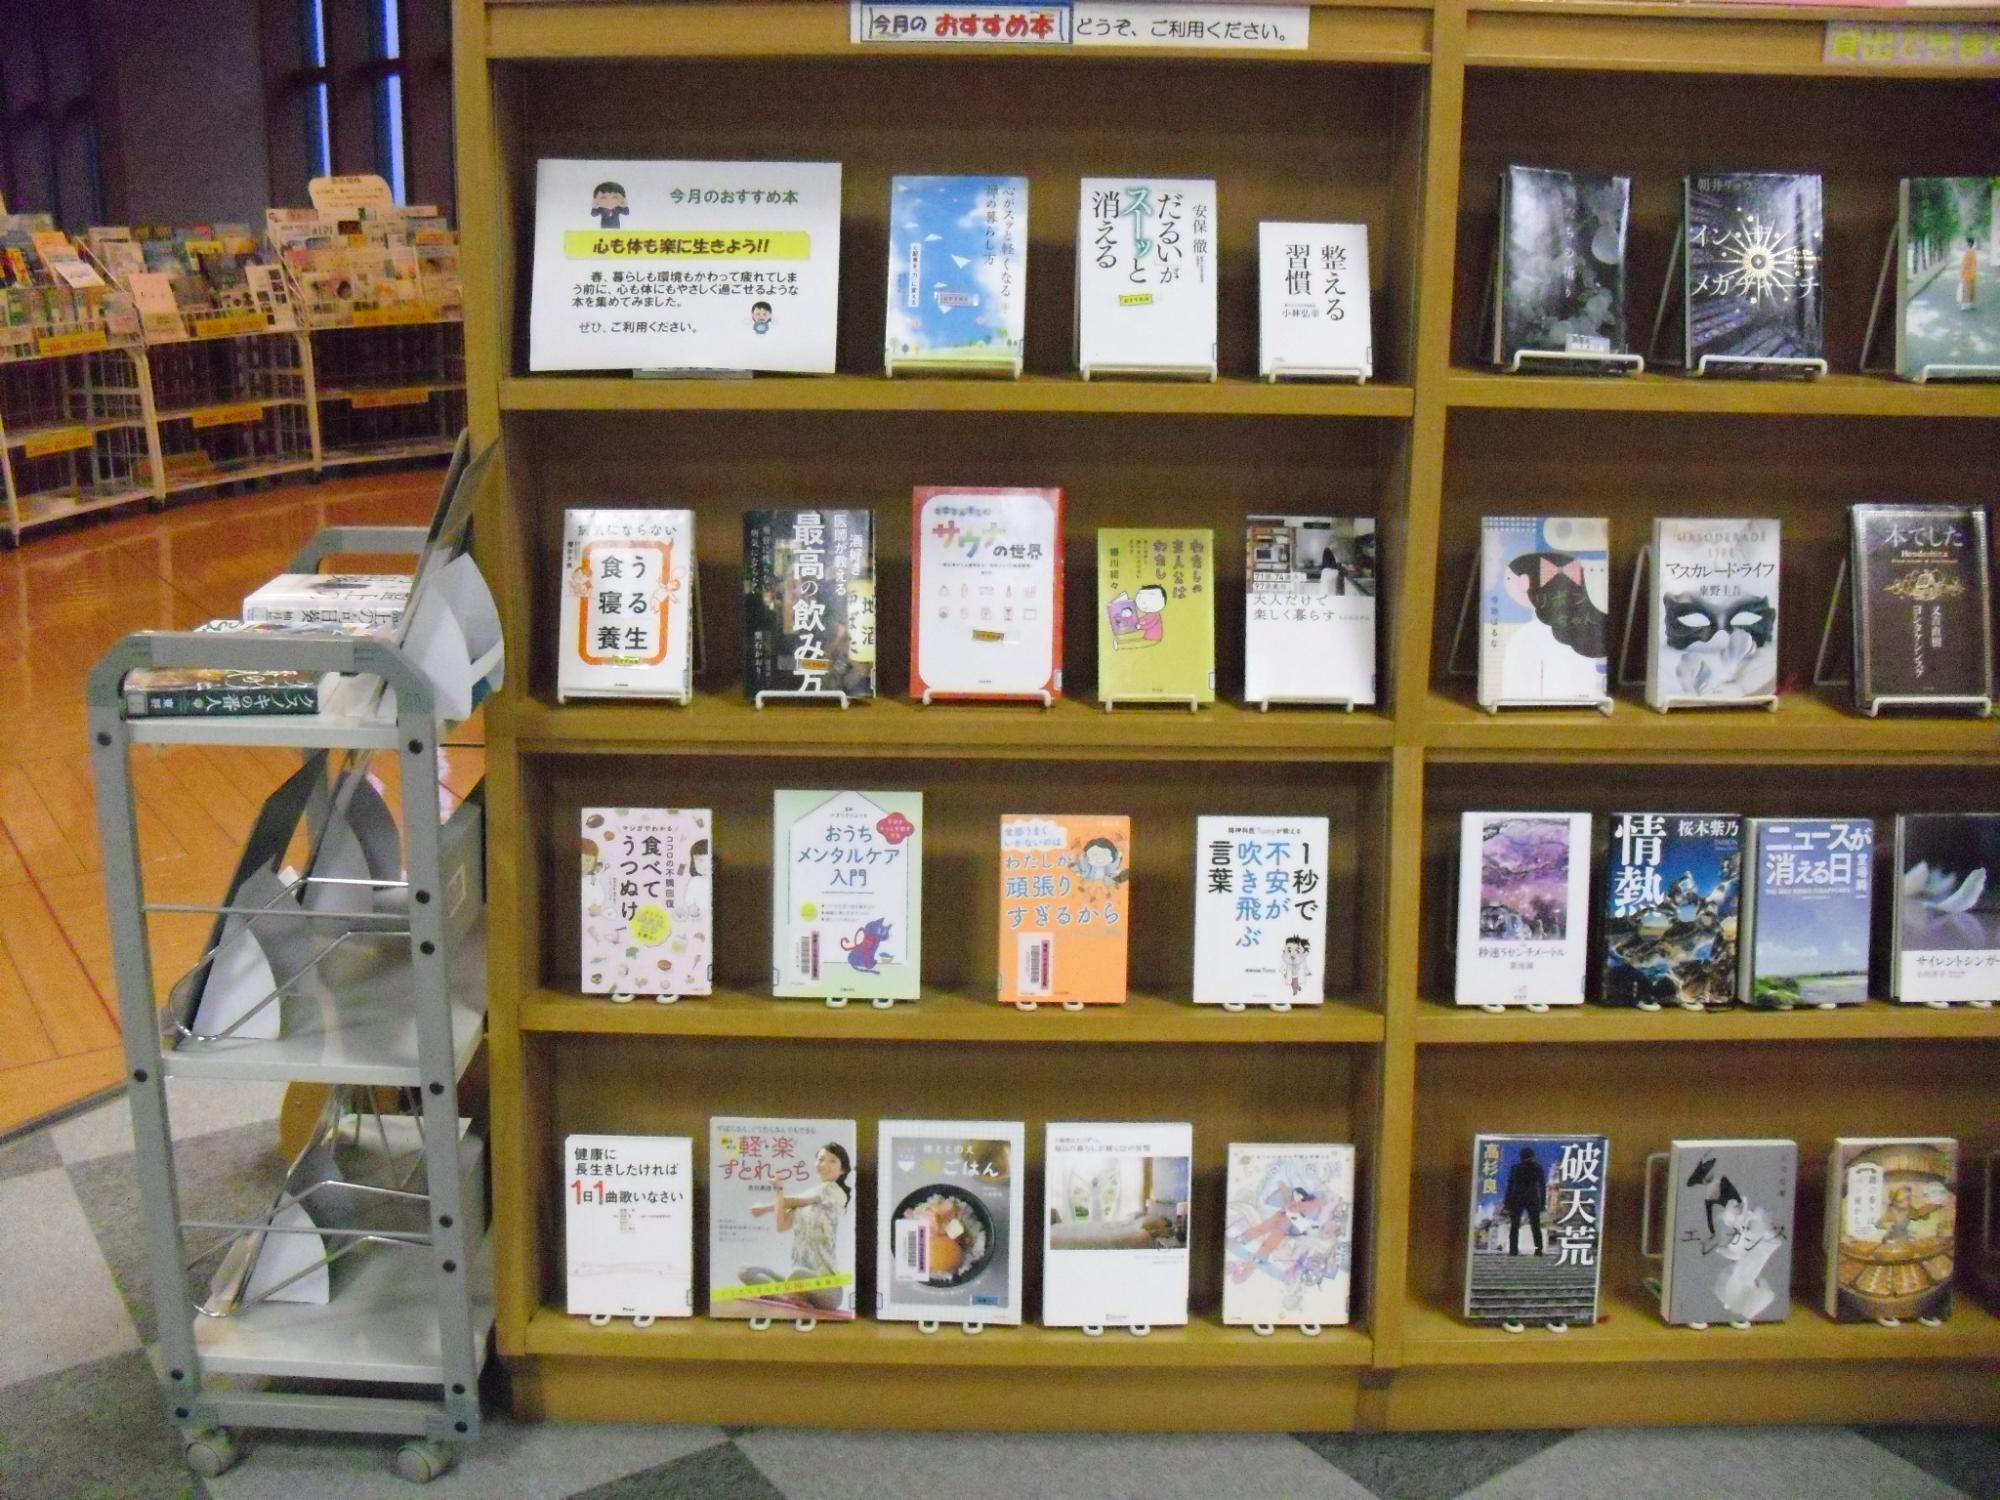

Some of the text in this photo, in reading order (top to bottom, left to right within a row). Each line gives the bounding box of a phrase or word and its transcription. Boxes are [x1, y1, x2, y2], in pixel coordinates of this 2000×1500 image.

[873, 12, 1055, 41] 今月の おすすめ本
[1076, 17, 1288, 42] どうぞ、ご利用ください。
[669, 188, 799, 206] 今月のおすすめ本
[1092, 190, 1120, 269] 消える
[1121, 186, 1154, 284] スーッと
[592, 237, 770, 255] 心も体も楽に生きよう!!
[590, 271, 798, 283] 春、暮らしも環境もかわって疲れてしま
[1285, 243, 1312, 295] 習慣
[572, 283, 800, 296] う前に、心も体にもやさしく過ごせるような
[1321, 244, 1347, 321] 整える
[571, 296, 683, 308] 本を集めてみました。
[578, 322, 698, 334] ぜひ、ご利用ください。
[1883, 523, 1964, 548] 本でした
[601, 555, 647, 580] 食う
[1665, 561, 1776, 580] マスカレード・ライフ
[598, 591, 648, 615] 寝る
[1253, 608, 1336, 622] 楽しく暮らす
[597, 626, 648, 651] 養生
[205, 695, 315, 713] クスノキの番人
[825, 825, 873, 844] おうち
[1678, 819, 1739, 837] 桜木紫乃
[1766, 824, 1873, 851] ニュースが
[641, 835, 663, 899] 食べて
[797, 847, 900, 865] メンタルケア
[1208, 840, 1234, 894] 言葉
[1615, 814, 1667, 918] 情熱
[619, 835, 639, 922] うつぬけ
[829, 868, 868, 887] 入門
[1264, 842, 1291, 920] 不安が
[1292, 842, 1320, 921] 1秒で
[1766, 852, 1851, 886] 消える日
[1006, 875, 1073, 898] 頑張り
[1235, 840, 1263, 947] 吹き飛ぶ
[1008, 902, 1120, 928] すぎるから
[575, 1148, 617, 1161] 健康に
[576, 1163, 679, 1176] 長生きしたければ
[943, 1159, 999, 1178] ごはん
[1482, 1143, 1499, 1195] 高杉良
[571, 1179, 684, 1206] 1日1曲歌いなさい
[1554, 1141, 1600, 1266] 破天荒
